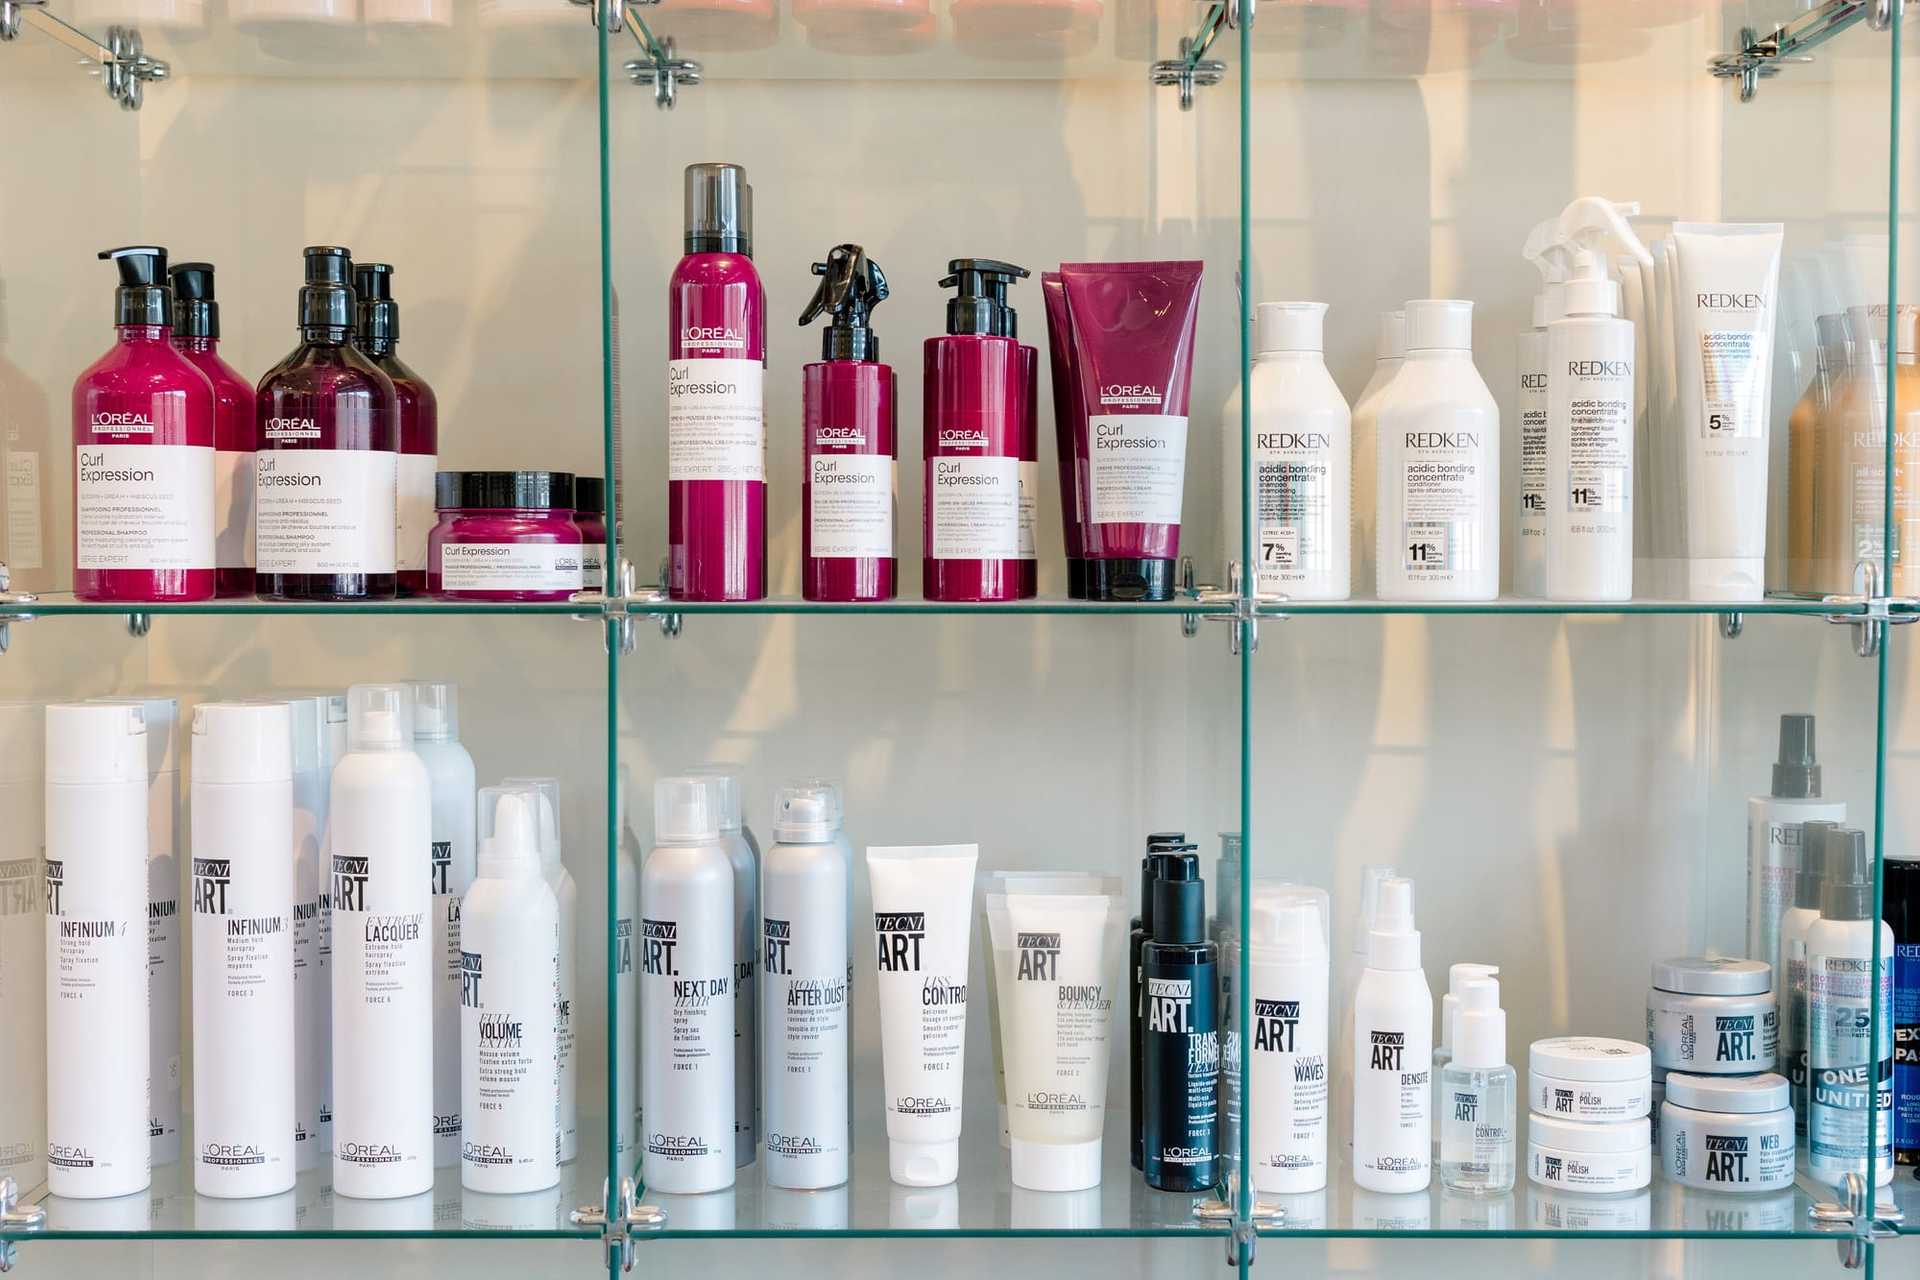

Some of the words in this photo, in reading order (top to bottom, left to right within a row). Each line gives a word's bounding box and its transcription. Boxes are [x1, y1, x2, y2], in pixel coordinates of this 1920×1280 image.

[1697, 294, 1767, 308] REDKEN
[681, 327, 743, 340] L'ORÉAL
[671, 367, 689, 381] Curl
[1569, 361, 1631, 376] REDKEN
[671, 381, 737, 397] Expression
[1100, 384, 1161, 396] L'ORÉAL
[92, 412, 154, 425] L'ORÉAL
[266, 417, 321, 430] L'ORÉAL
[816, 428, 865, 438] L'ORÉAL
[939, 430, 989, 440] L'ORÉAL
[1096, 424, 1123, 436] Curl
[1096, 436, 1166, 450] Expression
[1257, 433, 1330, 449] REDKEN
[1405, 433, 1479, 448] REDKEN
[81, 453, 104, 466] Curl
[259, 458, 275, 471] Curl
[815, 461, 837, 471] Curl
[938, 462, 960, 473] Curl
[1259, 464, 1287, 474] acidic
[1289, 464, 1326, 475] bonding
[1408, 464, 1436, 473] acidic
[1437, 464, 1475, 475] bonding
[81, 468, 154, 484] Expression
[259, 473, 321, 488] Expression
[815, 472, 875, 485] Expression
[938, 474, 999, 487] Expression
[1259, 474, 1316, 482] concentrate
[1408, 474, 1465, 482] concentrate
[445, 547, 461, 556] Curl
[463, 546, 510, 557] Expression
[194, 861, 230, 877] TECNI
[333, 858, 368, 874] TECNI
[61, 921, 115, 938] INFINIUM
[228, 918, 281, 935] INFINIUM
[876, 915, 924, 931] TECNI
[366, 924, 419, 941] LACQUER
[643, 922, 676, 939] TECNI
[1018, 935, 1060, 948] TECNI
[879, 934, 924, 971] ART
[1018, 950, 1060, 981] ART
[674, 980, 706, 998] NEXT
[710, 977, 728, 995] DAY
[1059, 986, 1102, 1001] BOUNCY
[1149, 982, 1191, 997] TECNI
[788, 988, 822, 1006] AFTER
[825, 985, 845, 1003] DUST
[922, 985, 967, 1006] CONTRO
[1256, 1002, 1299, 1017] TECNI
[1716, 1018, 1754, 1031] TECNI
[1763, 1012, 1775, 1027] WEB
[479, 1022, 522, 1039] VOLUME
[1254, 1018, 1298, 1052] ART
[1371, 1033, 1404, 1045] TECNI
[1371, 1045, 1404, 1070] ART
[1294, 1064, 1323, 1081] WAVES
[1824, 1067, 1868, 1085] ONE
[897, 1096, 950, 1108] L'ORÉAL
[1028, 1092, 1085, 1103] L'ORÉAL
[1580, 1095, 1602, 1105] POLISH
[1455, 1103, 1478, 1121] ART
[1555, 1098, 1574, 1112] ART
[649, 1133, 707, 1147] L'ORÉAL
[768, 1133, 821, 1147] L'ORÉAL
[1706, 1137, 1748, 1150] TECNI
[1760, 1135, 1780, 1150] WEB
[202, 1144, 264, 1156] L'ORÉAL
[340, 1143, 401, 1155] L'ORÉAL
[1164, 1147, 1209, 1157] L'ORÉAL
[1377, 1157, 1418, 1165] L'ORÉAL
[1545, 1165, 1562, 1181] ART
[1567, 1163, 1589, 1175] POLISH
